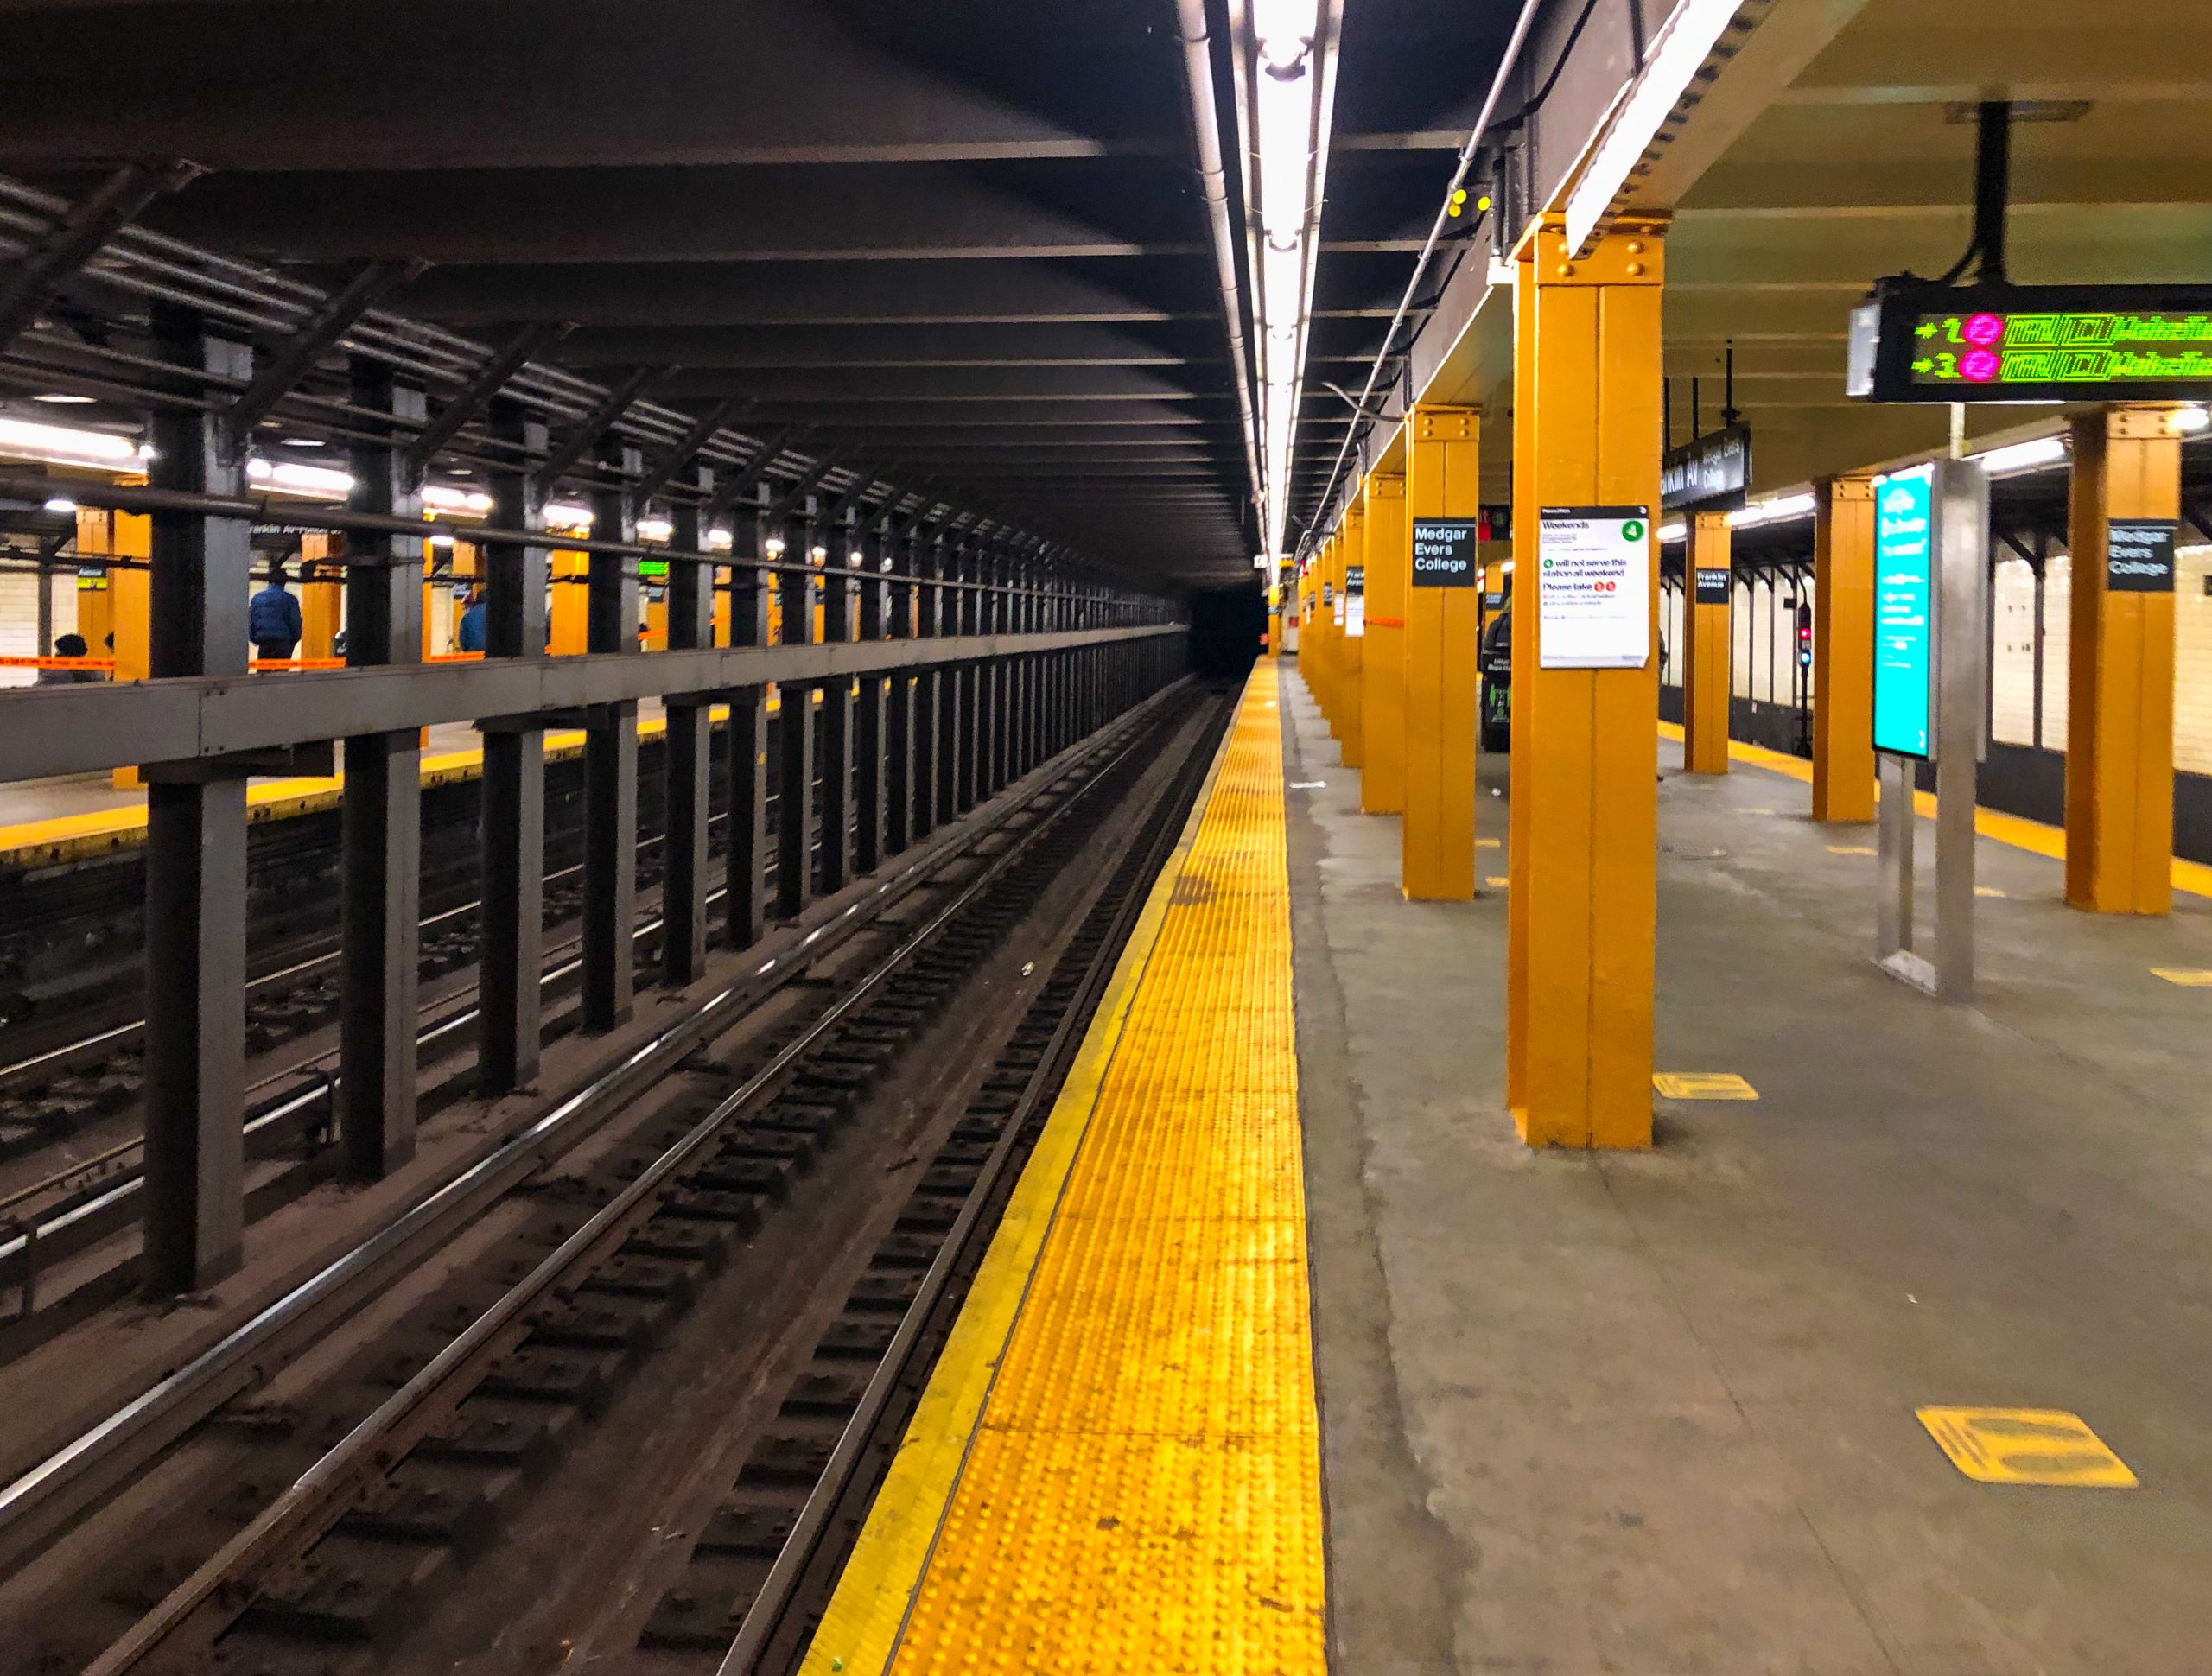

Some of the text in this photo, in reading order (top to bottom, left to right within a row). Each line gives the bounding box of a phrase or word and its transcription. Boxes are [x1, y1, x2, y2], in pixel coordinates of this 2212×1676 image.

[1415, 528, 1467, 543] Medgar
[1415, 543, 1452, 555] Evers
[1415, 557, 1467, 573] College
